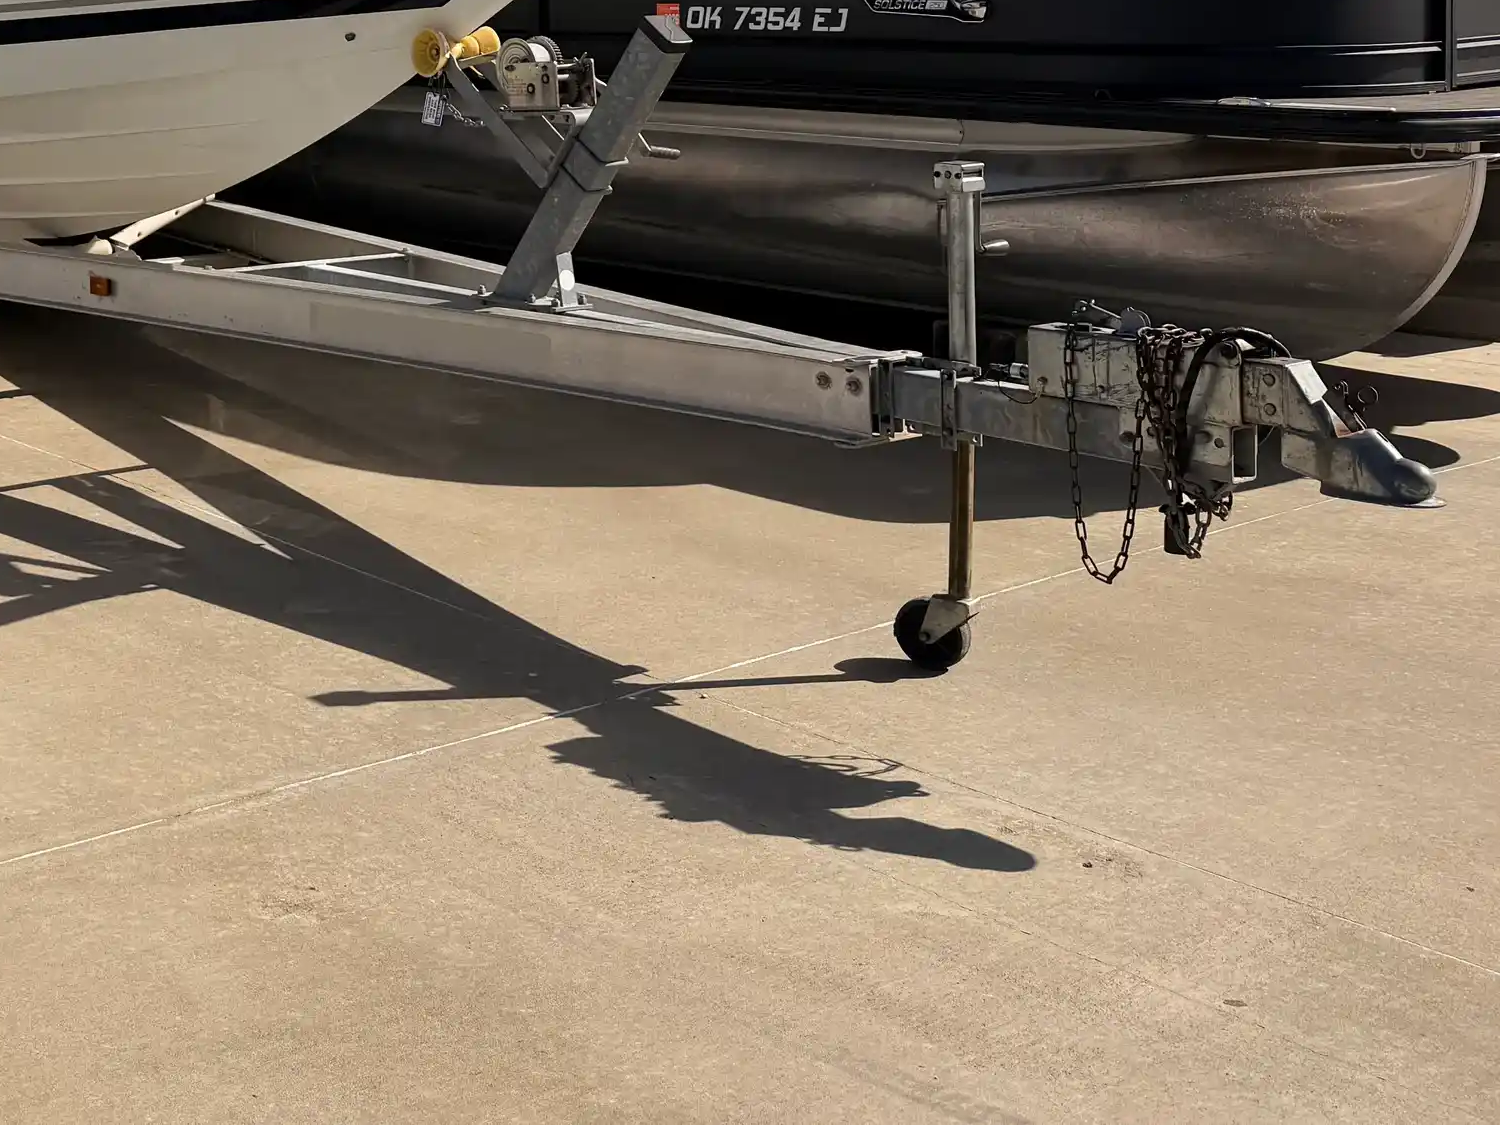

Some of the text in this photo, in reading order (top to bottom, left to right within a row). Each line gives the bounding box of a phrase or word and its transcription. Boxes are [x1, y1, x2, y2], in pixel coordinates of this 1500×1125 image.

[873, 0, 926, 10] SOLSTICE
[686, 6, 723, 30] OK
[733, 6, 802, 31] 7354
[812, 7, 849, 32] EJ
